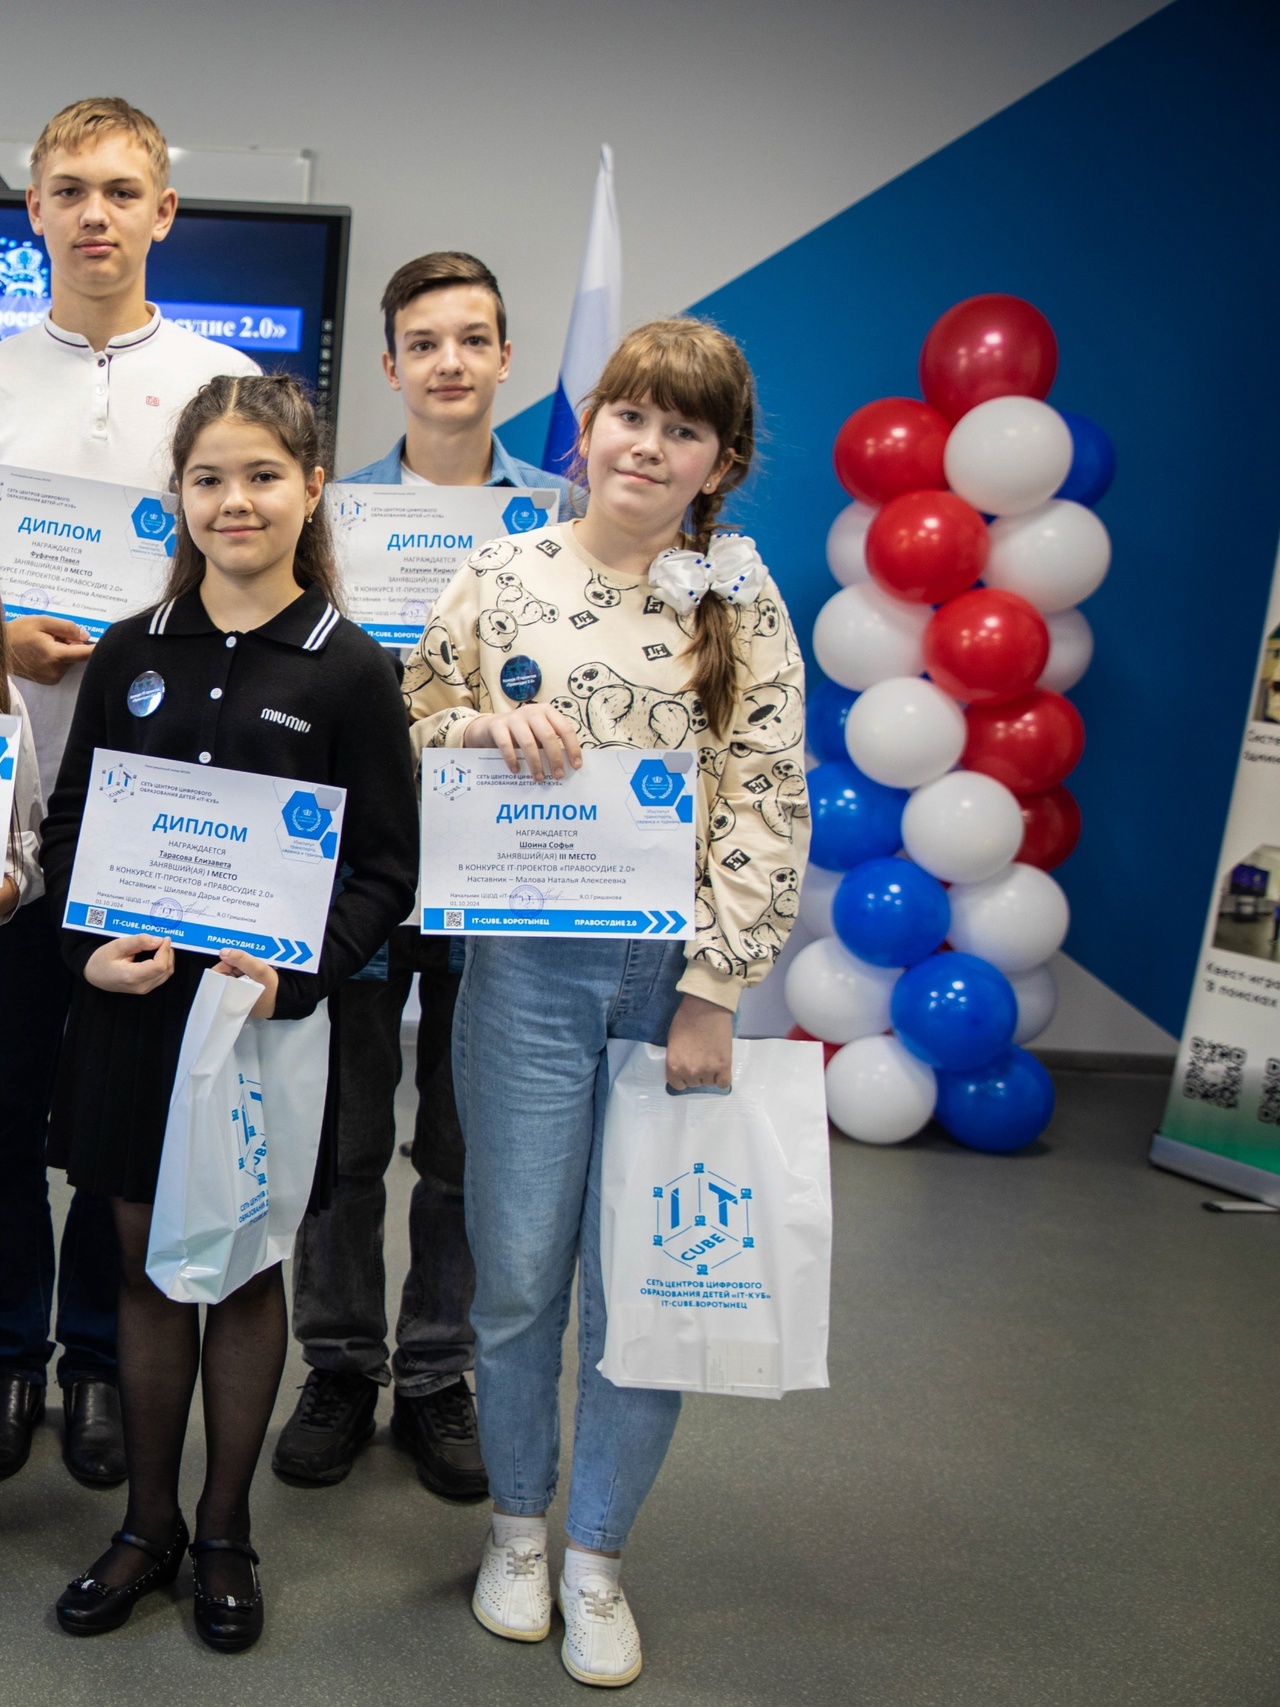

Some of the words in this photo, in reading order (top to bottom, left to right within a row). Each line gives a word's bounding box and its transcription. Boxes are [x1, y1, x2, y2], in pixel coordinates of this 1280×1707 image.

[239, 316, 287, 339] 2.0»
[17, 516, 102, 543] ДИПЛОМ
[31, 541, 83, 554] НАГРАЖДАЕТСЯ
[387, 534, 473, 551] ДИПЛОМ
[403, 556, 456, 564] НАГРАЖДАЕТСЯ
[69, 567, 93, 577] МЕСТО
[496, 804, 597, 824] ДИПЛОМ
[152, 813, 248, 843] ДИПЛОМ
[515, 829, 578, 838] НАГРАЖДАЕТСЯ
[168, 840, 227, 856] НАГРАЖДАЕТСЯ
[519, 841, 547, 849] Шоина
[548, 841, 574, 849] Софья
[159, 850, 194, 863] Тарасова
[194, 856, 232, 869] Елизавета
[497, 851, 558, 861] ЗАНЯВШИЙ(АЯ)
[568, 853, 597, 861] МЕСТО
[149, 859, 206, 876] ЗАНЯВШИЙ(АЯ)
[210, 870, 238, 881] МЕСТО
[458, 863, 464, 871] В
[465, 864, 505, 872] КОНКУРСЕ
[507, 864, 558, 872] IT-ПРОЕКТОВ
[559, 864, 617, 873] «ПРАВОСУДИЕ
[619, 865, 636, 873] 2.0»
[115, 866, 154, 879] КОНКУРСЕ
[154, 872, 202, 887] IT-ПРОЕКТОВ
[203, 881, 257, 896] «ПРАВОСУДИЕ
[516, 876, 546, 884] Малова
[547, 876, 579, 884] Наталья
[580, 876, 627, 884] Алексеевна
[119, 878, 157, 890] Наставник
[163, 885, 197, 897] Шиляева
[197, 891, 221, 901] Дарья
[221, 895, 260, 908] Сергеевна
[207, 935, 255, 949] ПРАВОСУДИЕ
[680, 1233, 726, 1261] CUBE
[646, 1278, 664, 1287] СЕТЬ
[664, 1280, 704, 1289] ЦЕНТРОВ
[640, 1287, 701, 1298] ОБРАЗОВАНИЯ
[702, 1290, 730, 1299] ДЕТЕЙ
